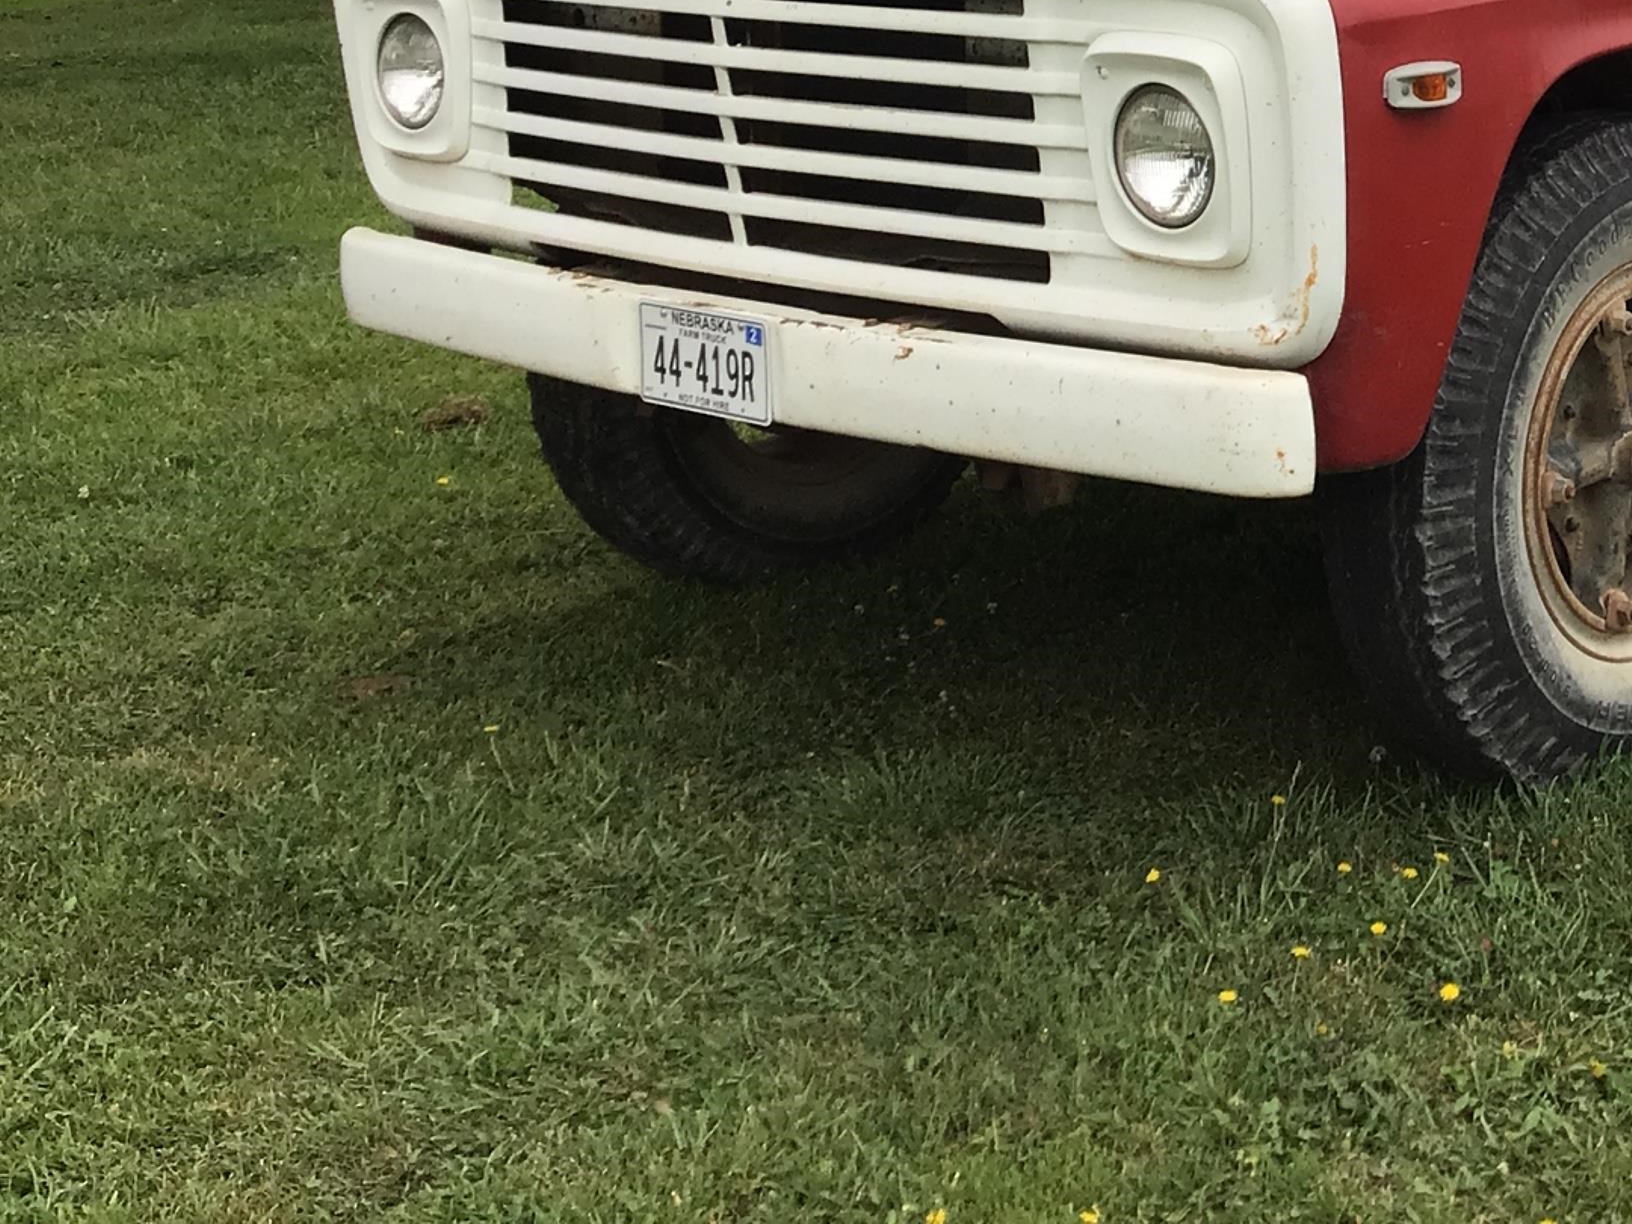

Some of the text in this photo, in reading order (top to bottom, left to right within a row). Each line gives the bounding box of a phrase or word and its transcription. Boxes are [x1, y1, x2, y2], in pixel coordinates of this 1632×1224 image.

[671, 311, 734, 334] NEBRASKA
[748, 328, 759, 343] 2
[654, 335, 754, 402] 44-419R
